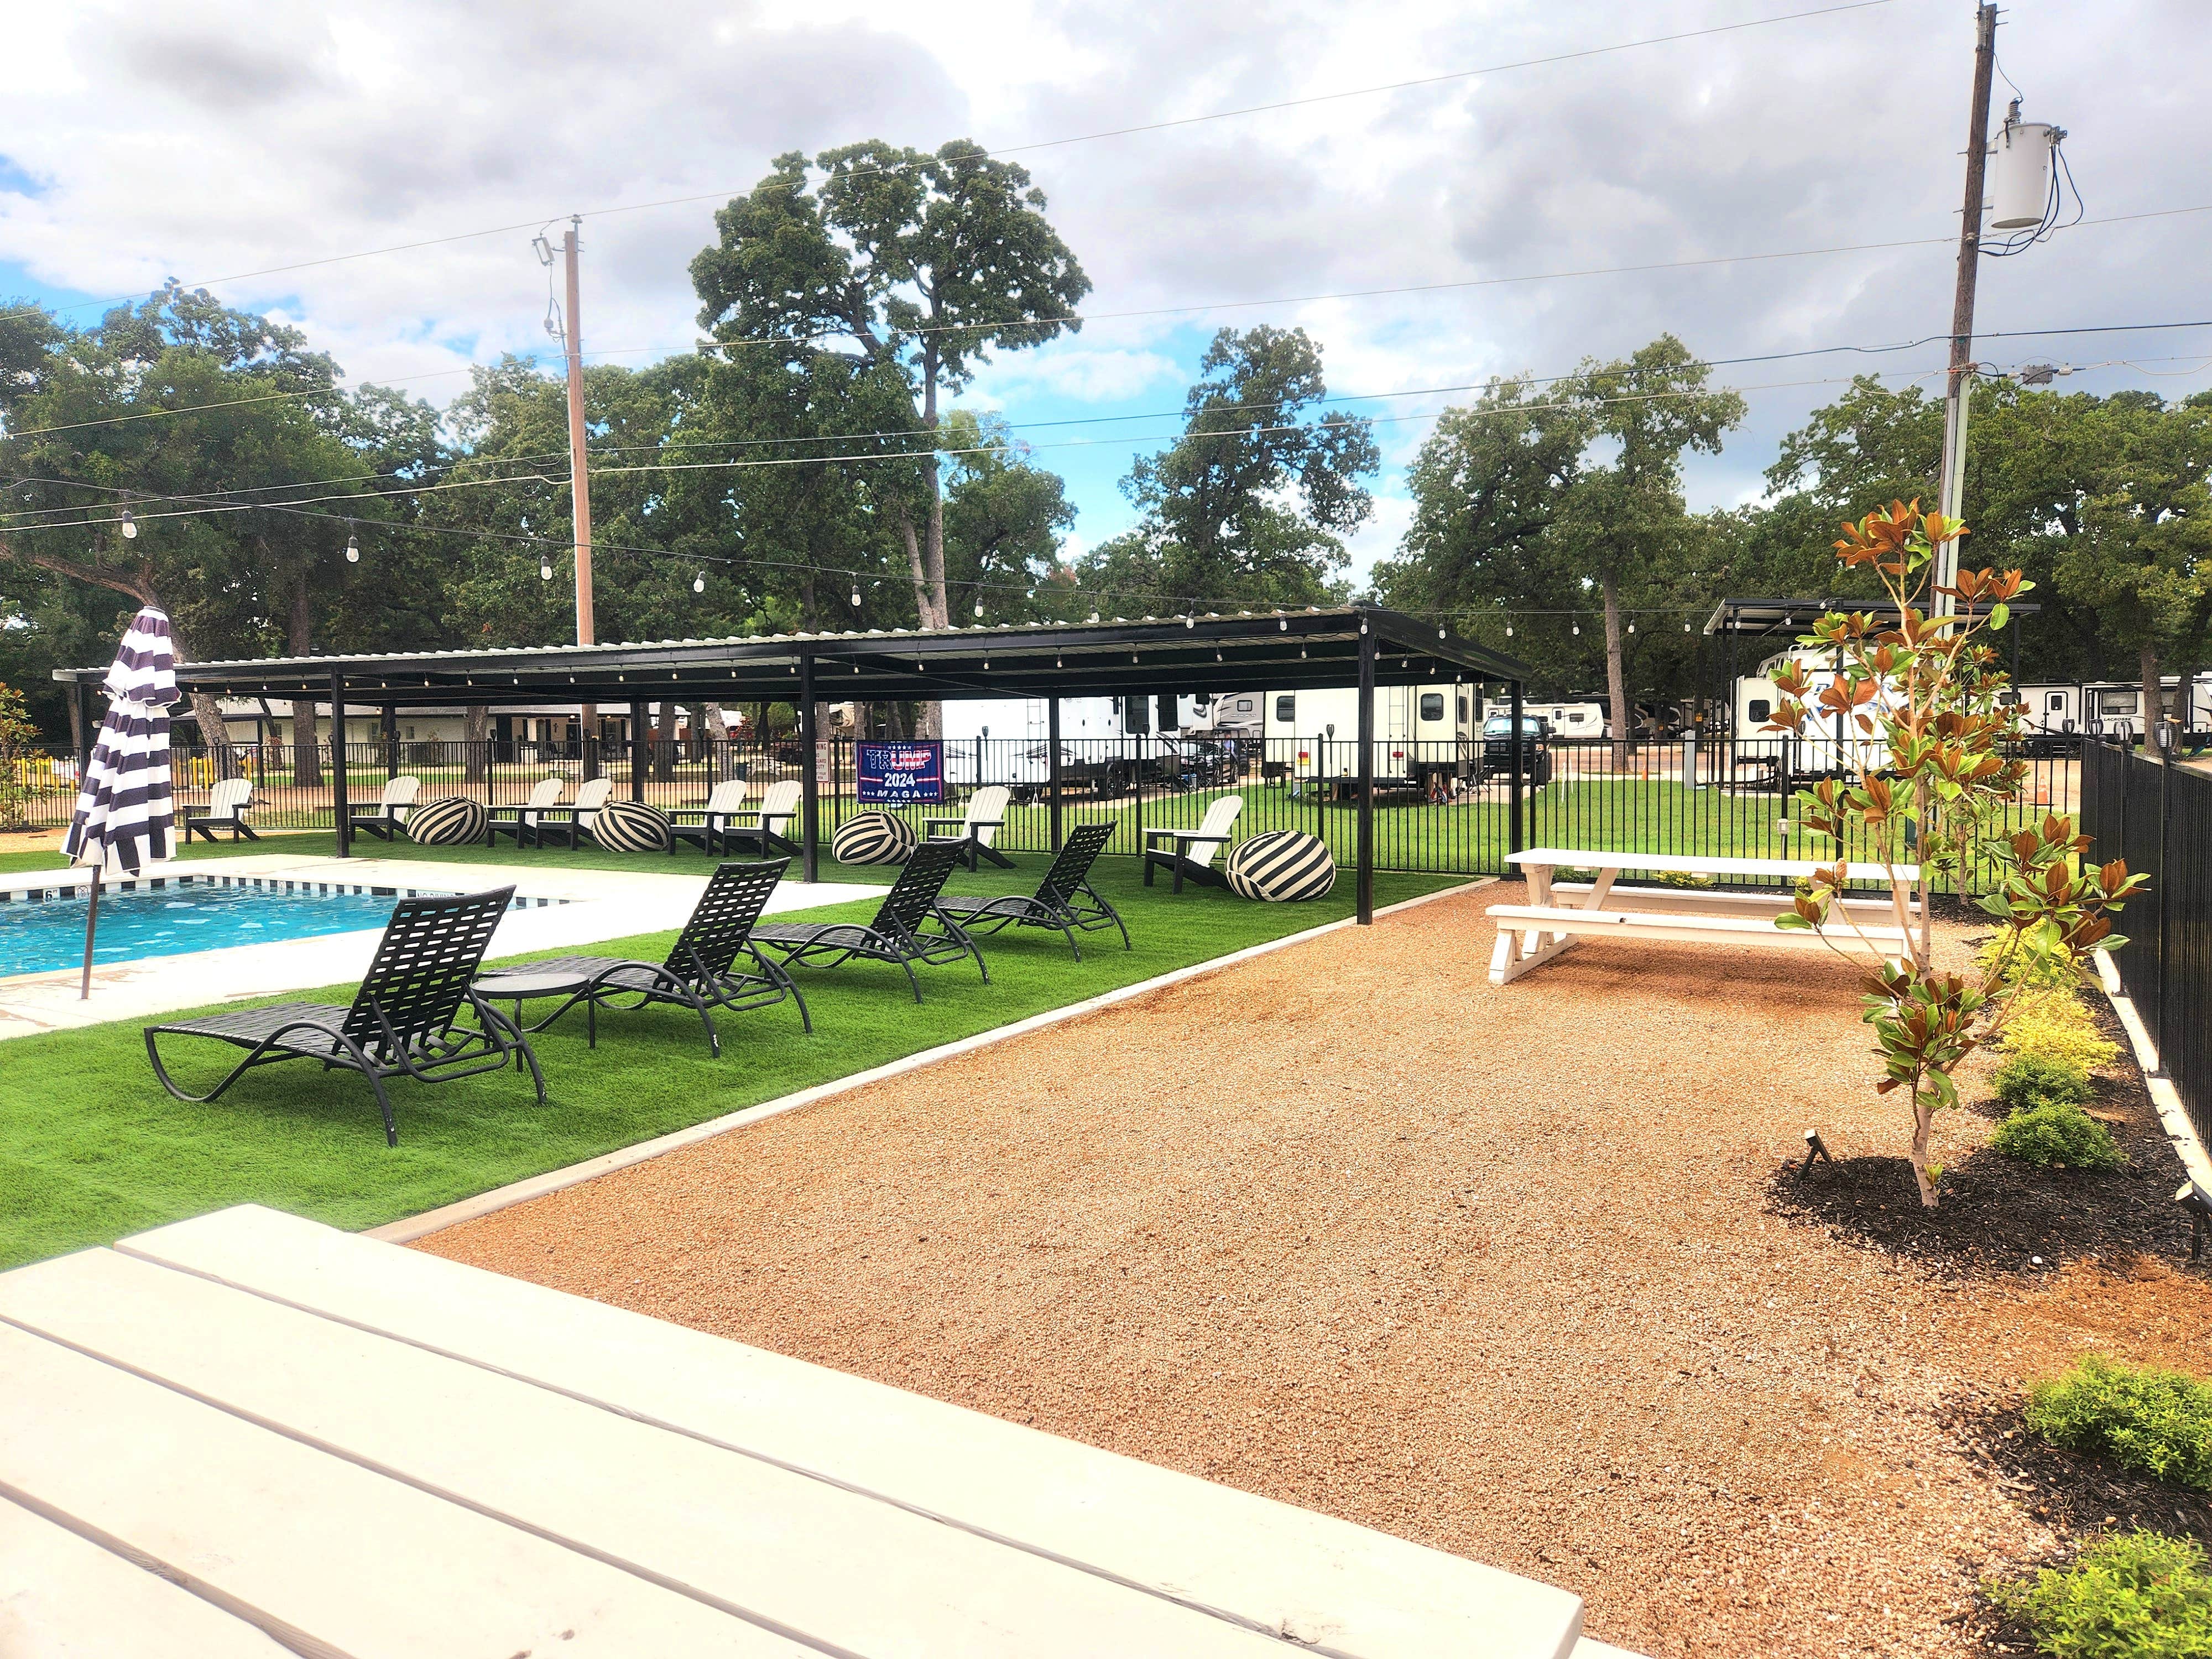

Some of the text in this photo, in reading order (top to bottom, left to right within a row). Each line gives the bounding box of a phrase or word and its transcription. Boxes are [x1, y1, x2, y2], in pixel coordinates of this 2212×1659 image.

[867, 749, 931, 770] TRUMP
[884, 773, 916, 787] 2024
[877, 790, 921, 798] MAGA
[45, 890, 53, 901] 6
